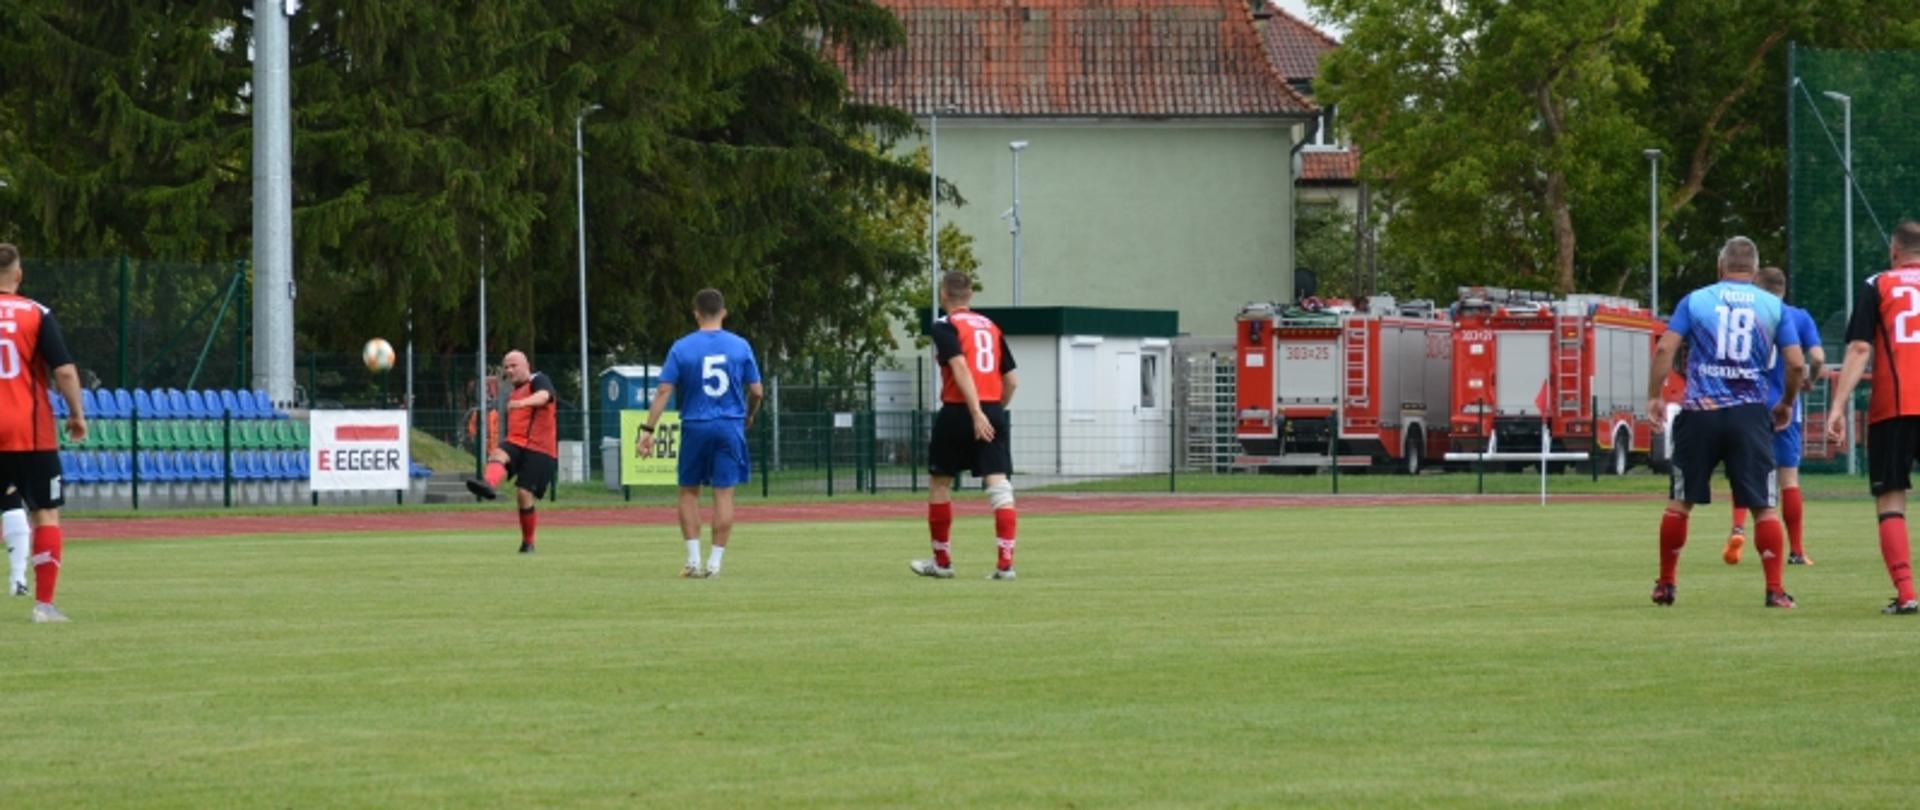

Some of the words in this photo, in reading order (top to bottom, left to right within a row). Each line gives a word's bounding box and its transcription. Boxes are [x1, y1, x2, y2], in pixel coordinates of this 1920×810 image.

[974, 329, 995, 374] 8
[1714, 305, 1755, 361] 18
[702, 354, 730, 397] 5
[336, 449, 400, 470] EGGER
